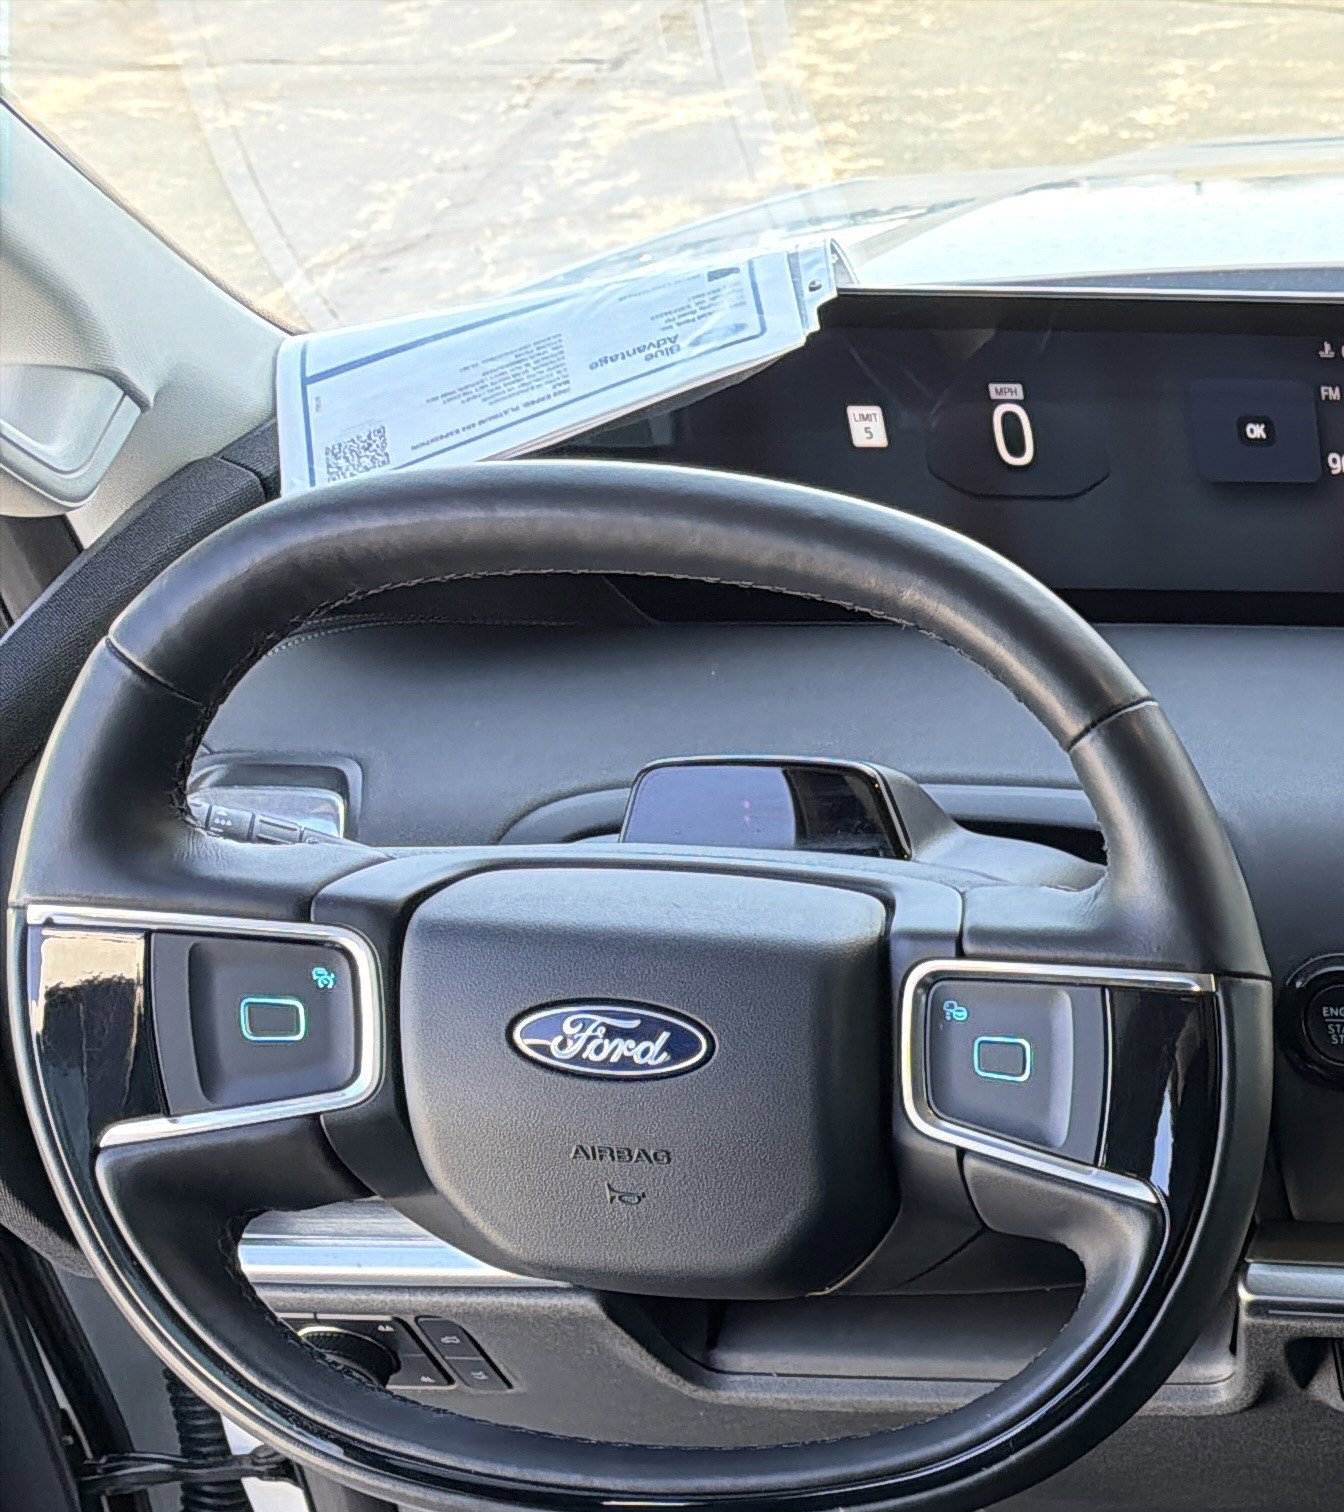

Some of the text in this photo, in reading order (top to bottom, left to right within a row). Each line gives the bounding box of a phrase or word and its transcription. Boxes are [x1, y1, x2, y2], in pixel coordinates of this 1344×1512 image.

[994, 386, 1018, 397] MPH
[1321, 386, 1341, 401] FM
[864, 427, 873, 439] 5
[993, 403, 1034, 466] 0
[1246, 423, 1267, 440] OK
[549, 1013, 671, 1066] Ford
[571, 1144, 672, 1165] AIRBAG
